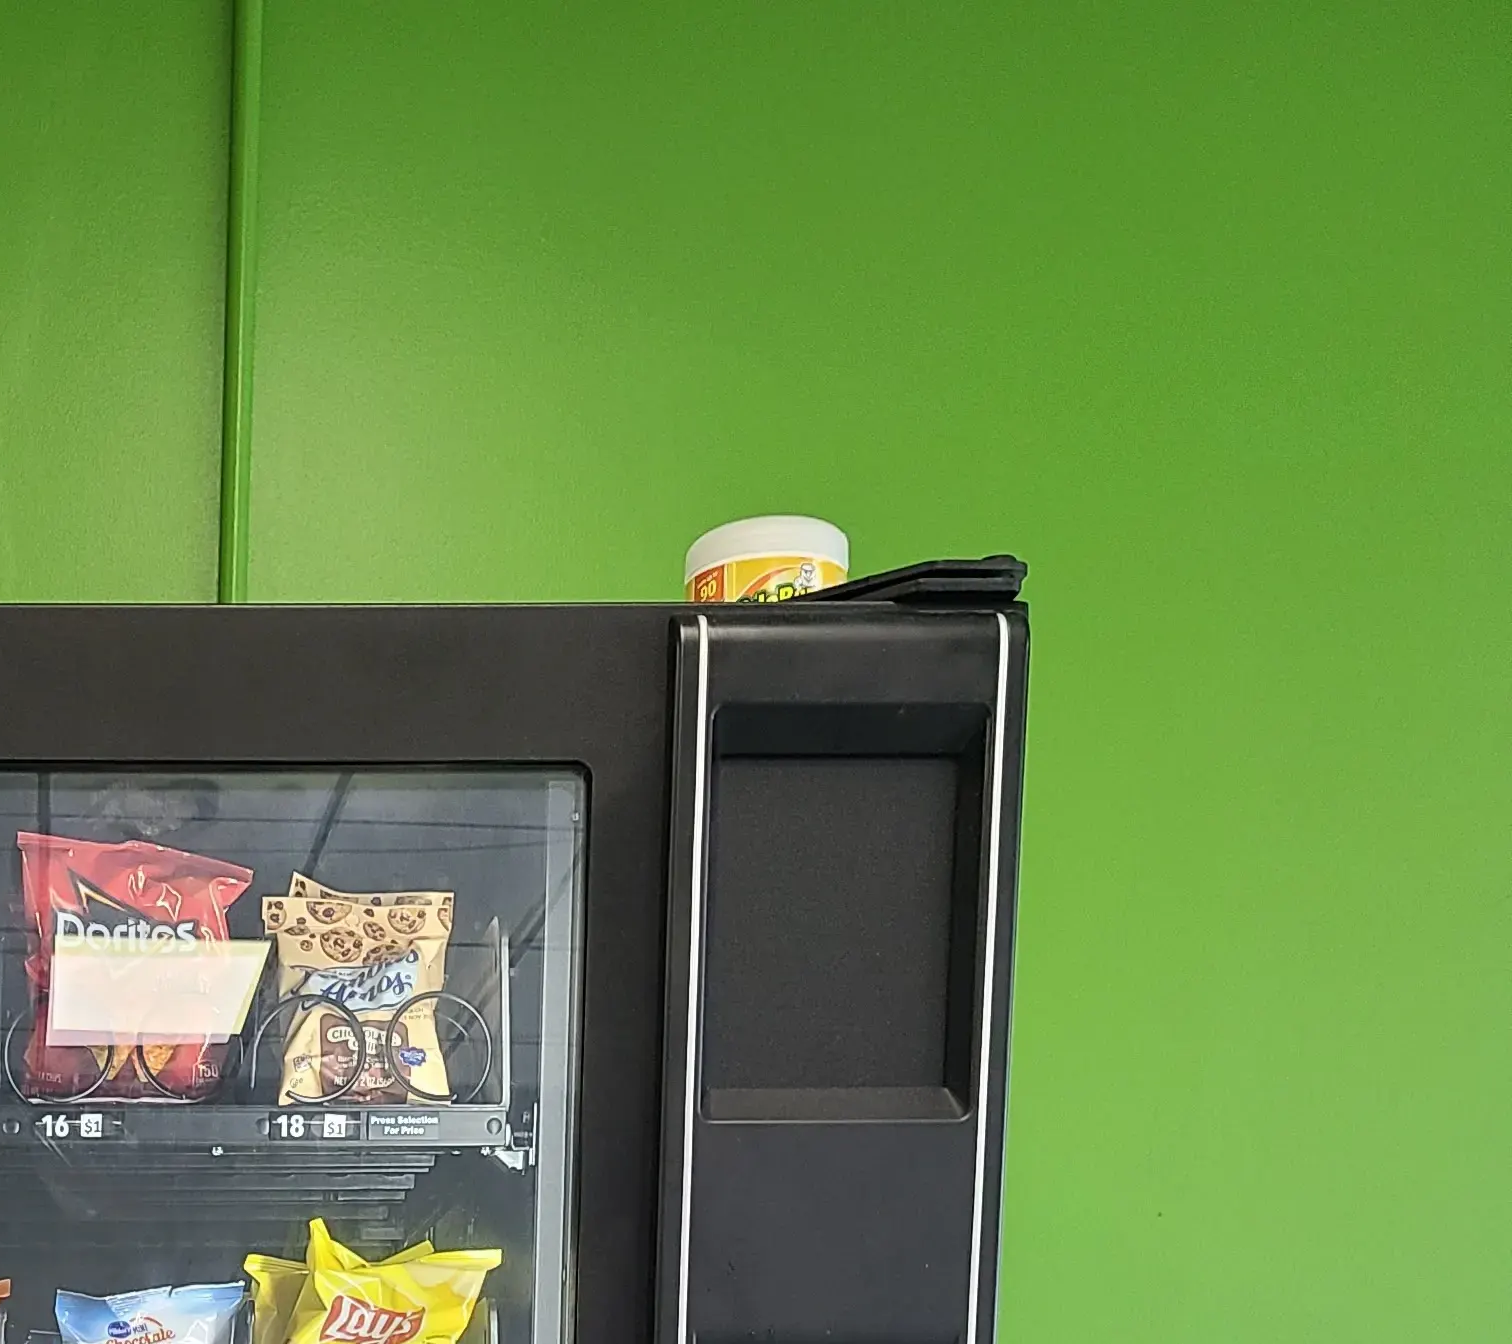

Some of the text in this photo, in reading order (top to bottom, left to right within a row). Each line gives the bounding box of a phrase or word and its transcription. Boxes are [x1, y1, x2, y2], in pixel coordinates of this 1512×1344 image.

[57, 911, 196, 953] Doritos
[42, 1115, 101, 1137] 16 $1
[277, 1115, 344, 1137] 18 $1
